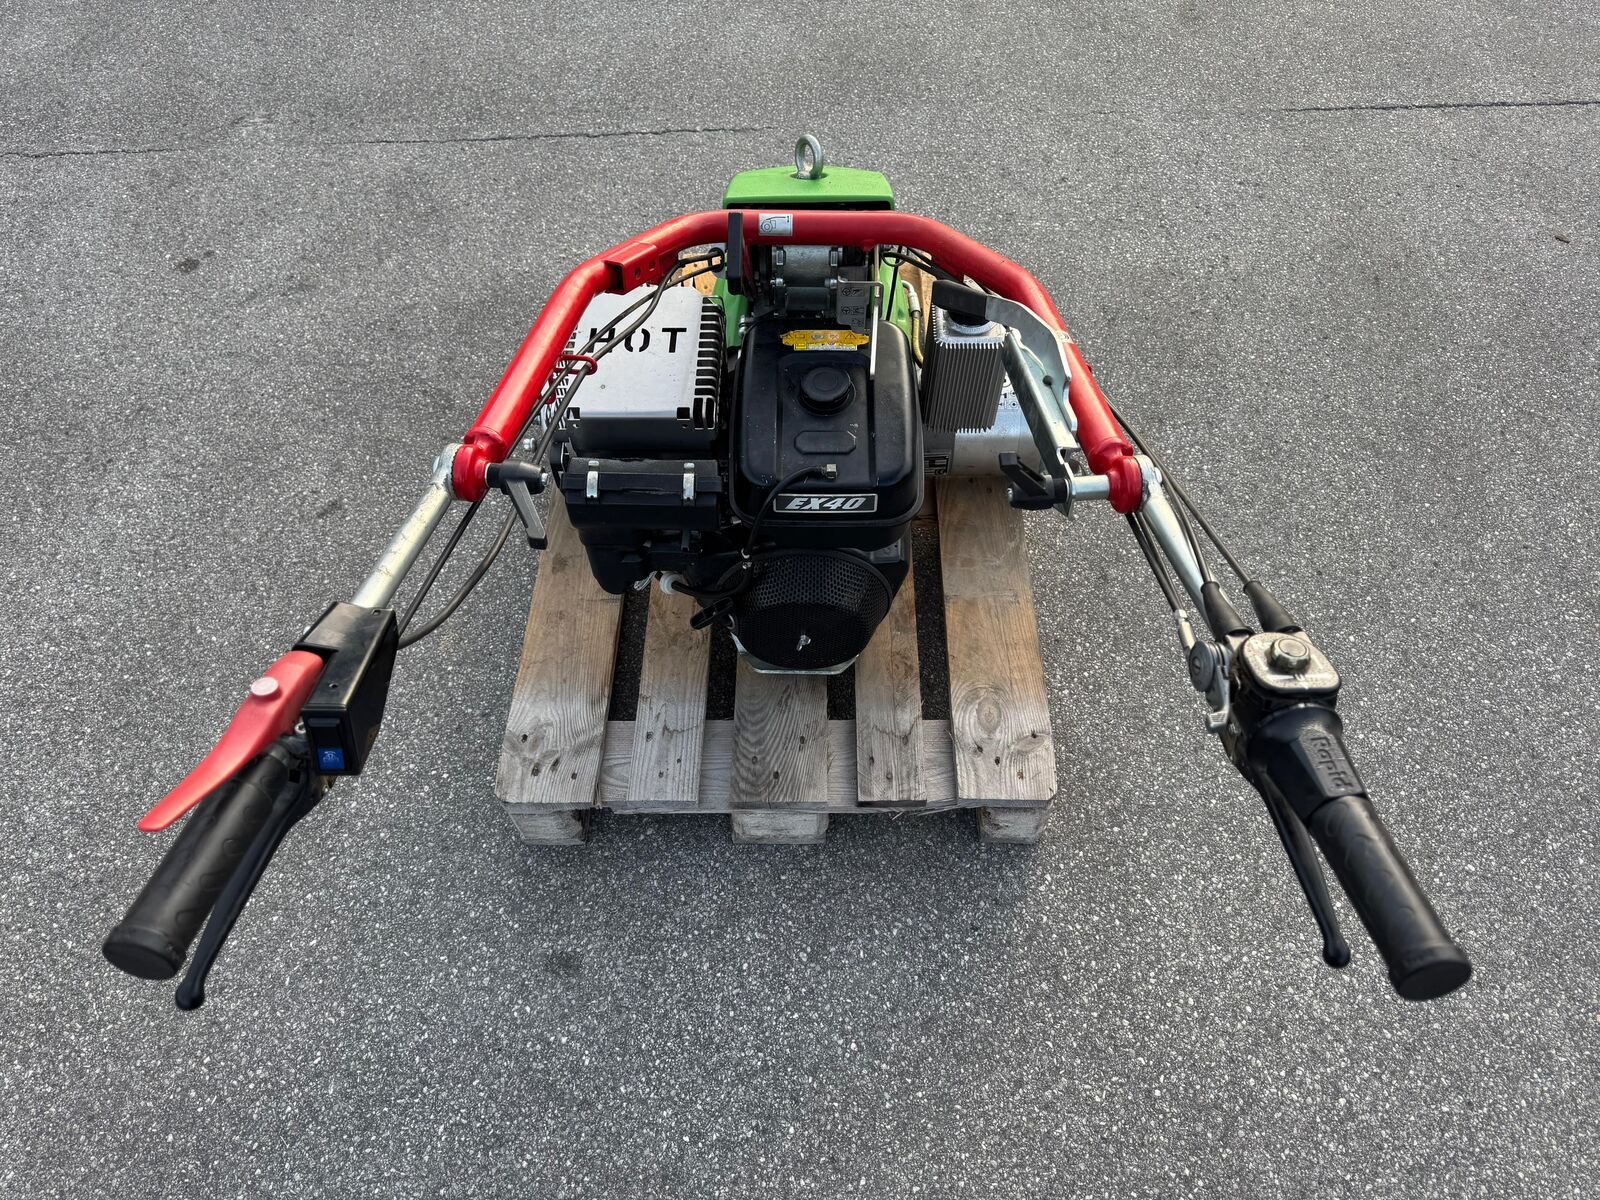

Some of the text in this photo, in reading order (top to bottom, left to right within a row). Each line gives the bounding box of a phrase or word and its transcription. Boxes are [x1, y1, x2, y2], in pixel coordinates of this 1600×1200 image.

[587, 327, 687, 353] HOT
[784, 497, 867, 510] EX40
[1310, 736, 1355, 788] Rapid
